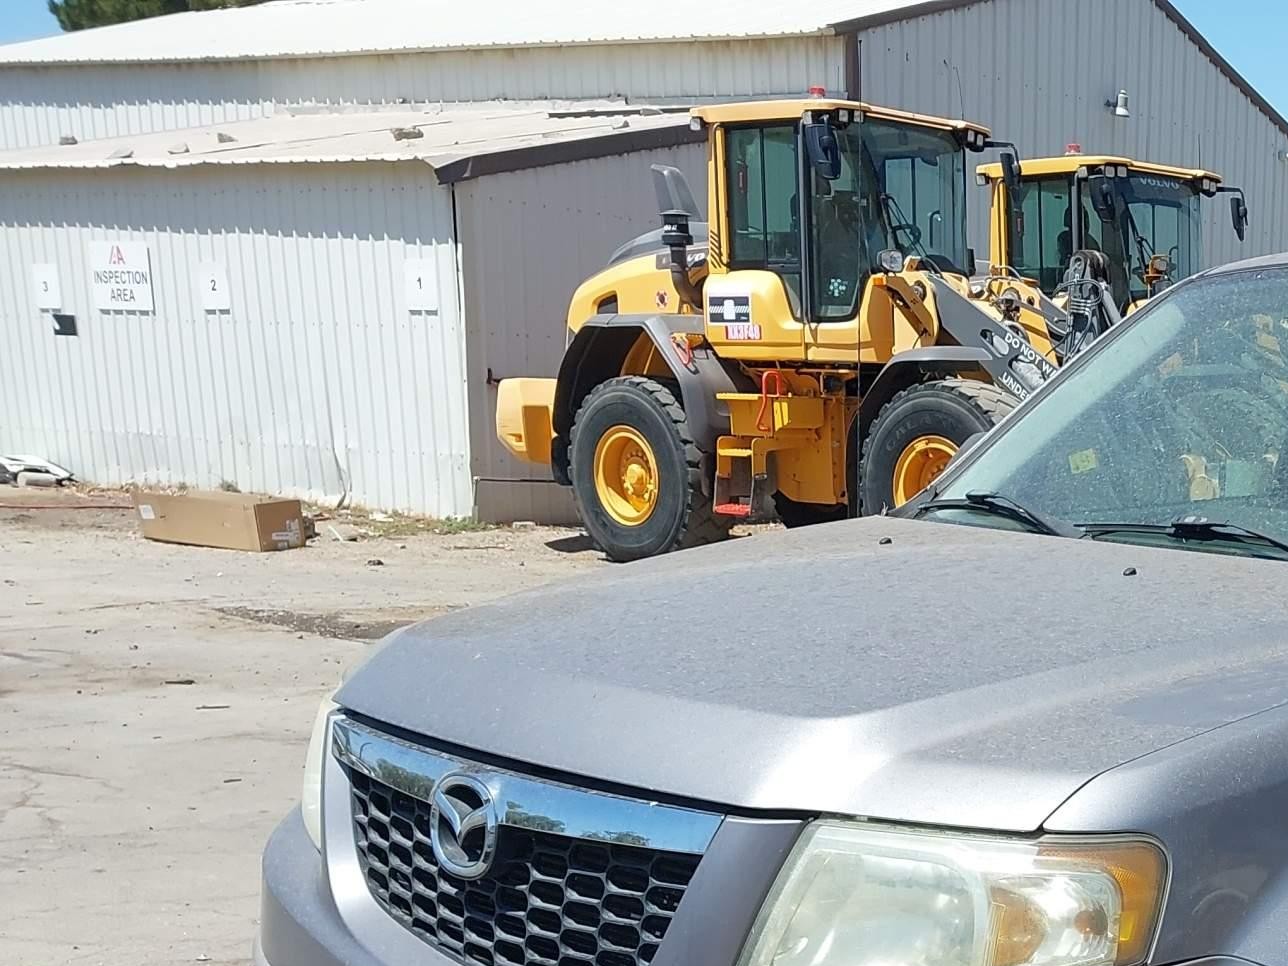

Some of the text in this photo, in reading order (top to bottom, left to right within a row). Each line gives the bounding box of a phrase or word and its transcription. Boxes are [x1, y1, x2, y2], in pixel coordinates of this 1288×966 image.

[1139, 177, 1180, 190] VOLVO
[93, 270, 148, 285] INSPECTION
[416, 276, 422, 289] 1
[43, 281, 49, 292] 3
[210, 279, 217, 291] 2
[110, 288, 136, 302] AREA
[1004, 332, 1020, 348] DO
[1020, 344, 1042, 364] NOT
